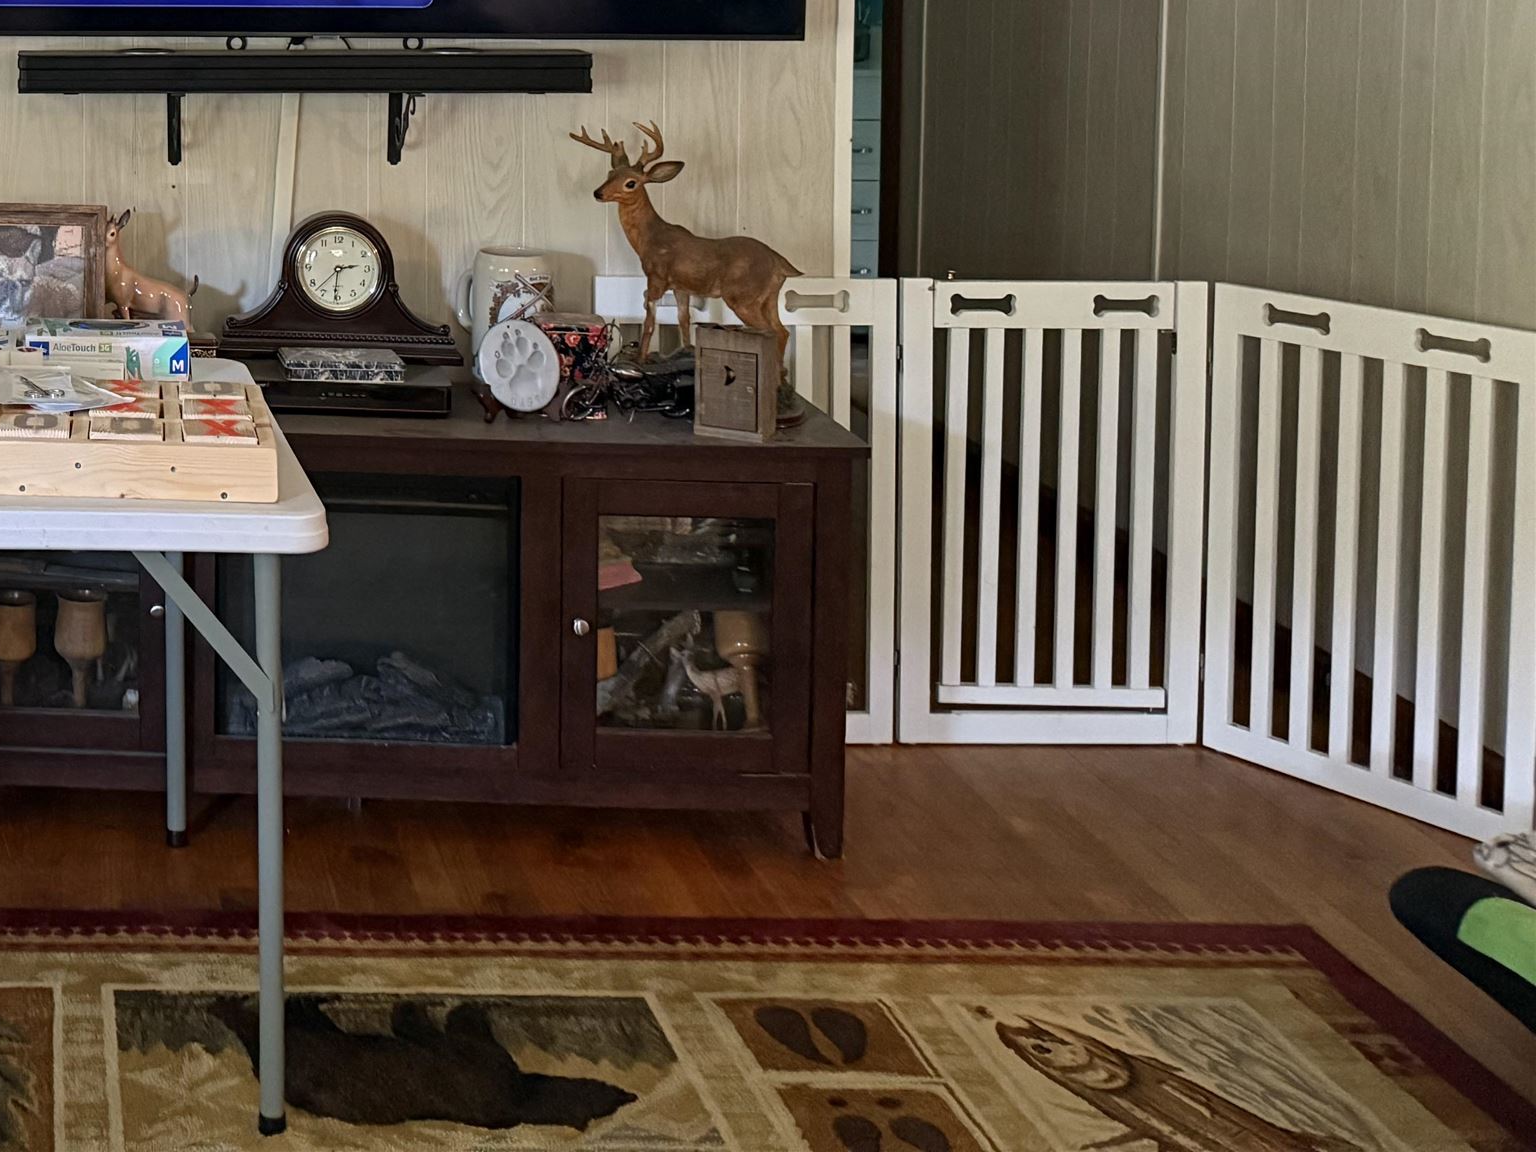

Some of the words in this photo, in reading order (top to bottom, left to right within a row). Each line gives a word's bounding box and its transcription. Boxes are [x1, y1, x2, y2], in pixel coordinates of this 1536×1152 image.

[321, 239, 327, 247] 11
[334, 236, 344, 244] 12
[360, 250, 367, 258] 2
[305, 263, 312, 271] 9
[364, 265, 371, 273] 3
[309, 278, 316, 287] 8
[359, 279, 366, 287] 4
[319, 289, 327, 297] 7
[349, 289, 357, 297] 5
[53, 343, 96, 352] AloeTouch
[171, 359, 185, 372] M
